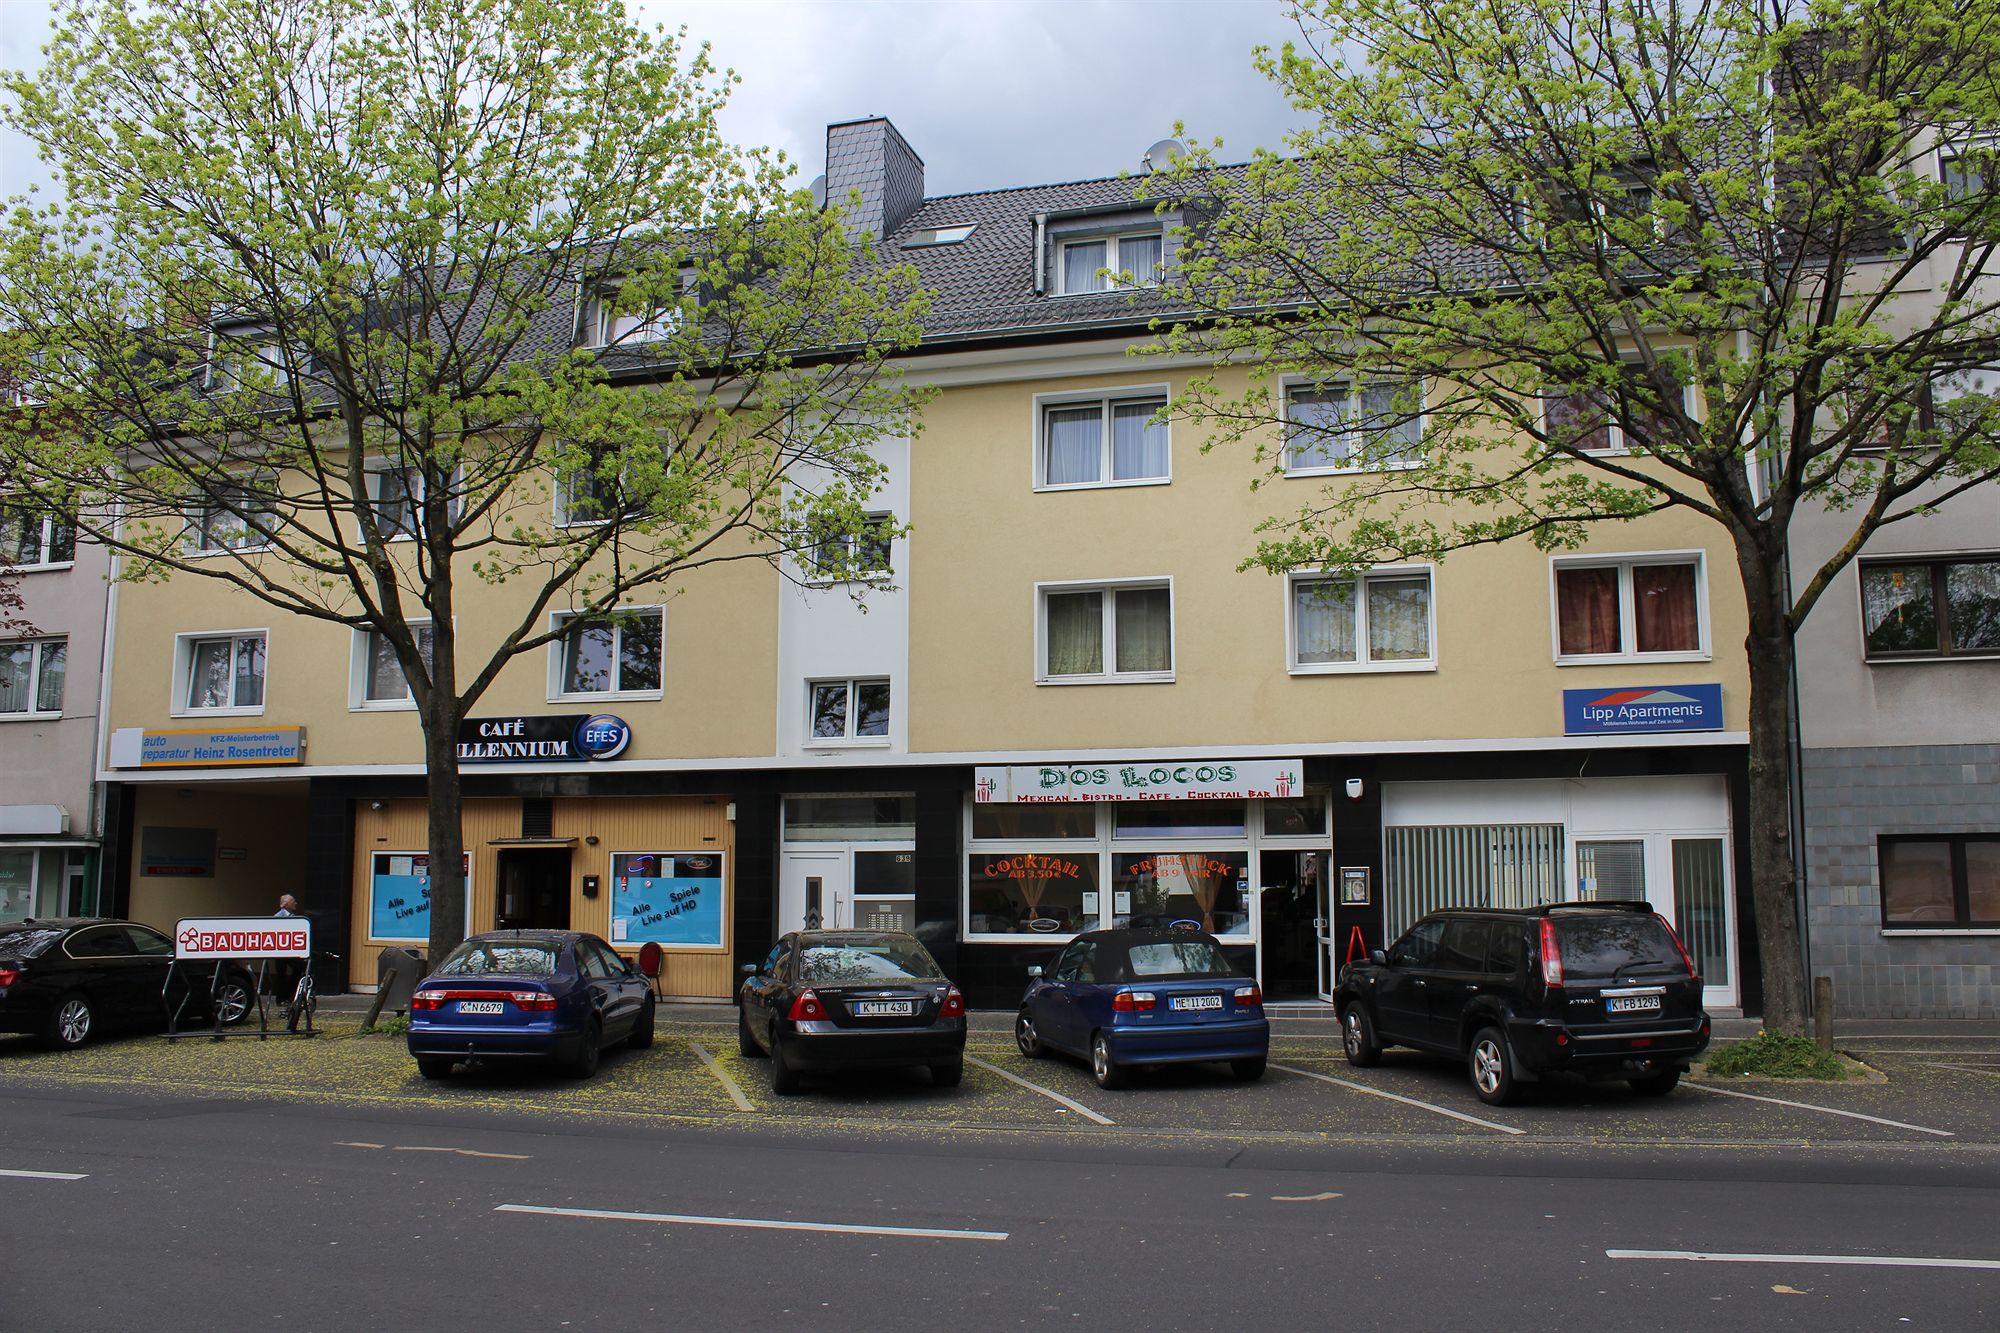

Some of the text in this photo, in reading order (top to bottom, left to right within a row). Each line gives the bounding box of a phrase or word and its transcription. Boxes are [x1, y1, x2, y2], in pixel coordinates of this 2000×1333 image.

[1583, 704, 1703, 721] Lipp Apartments
[480, 719, 525, 737] CAFÉ
[143, 736, 167, 747] auto
[210, 734, 280, 743] KFZ-Meisterbetrieb
[586, 730, 618, 743] EFES
[142, 745, 296, 762] reparatur Heinz Rosentreter
[984, 855, 1080, 879] COCKTAIL
[1129, 855, 1233, 876] FRÜHSTÜCK
[1008, 870, 1025, 879] AB
[1151, 869, 1169, 878] AB
[1171, 869, 1180, 877] 9
[669, 886, 701, 904] Spiele
[388, 898, 405, 909] Alle
[395, 900, 430, 919] Live auf
[632, 903, 651, 916] Alle
[641, 900, 697, 926] Live auf HD
[201, 932, 306, 952] BAUHAUS
[460, 1002, 467, 1012] K
[863, 1002, 908, 1012] K TT 430
[1175, 998, 1186, 1008] ME
[1201, 997, 1220, 1006] 2002
[1612, 996, 1659, 1010] K FB 1293
